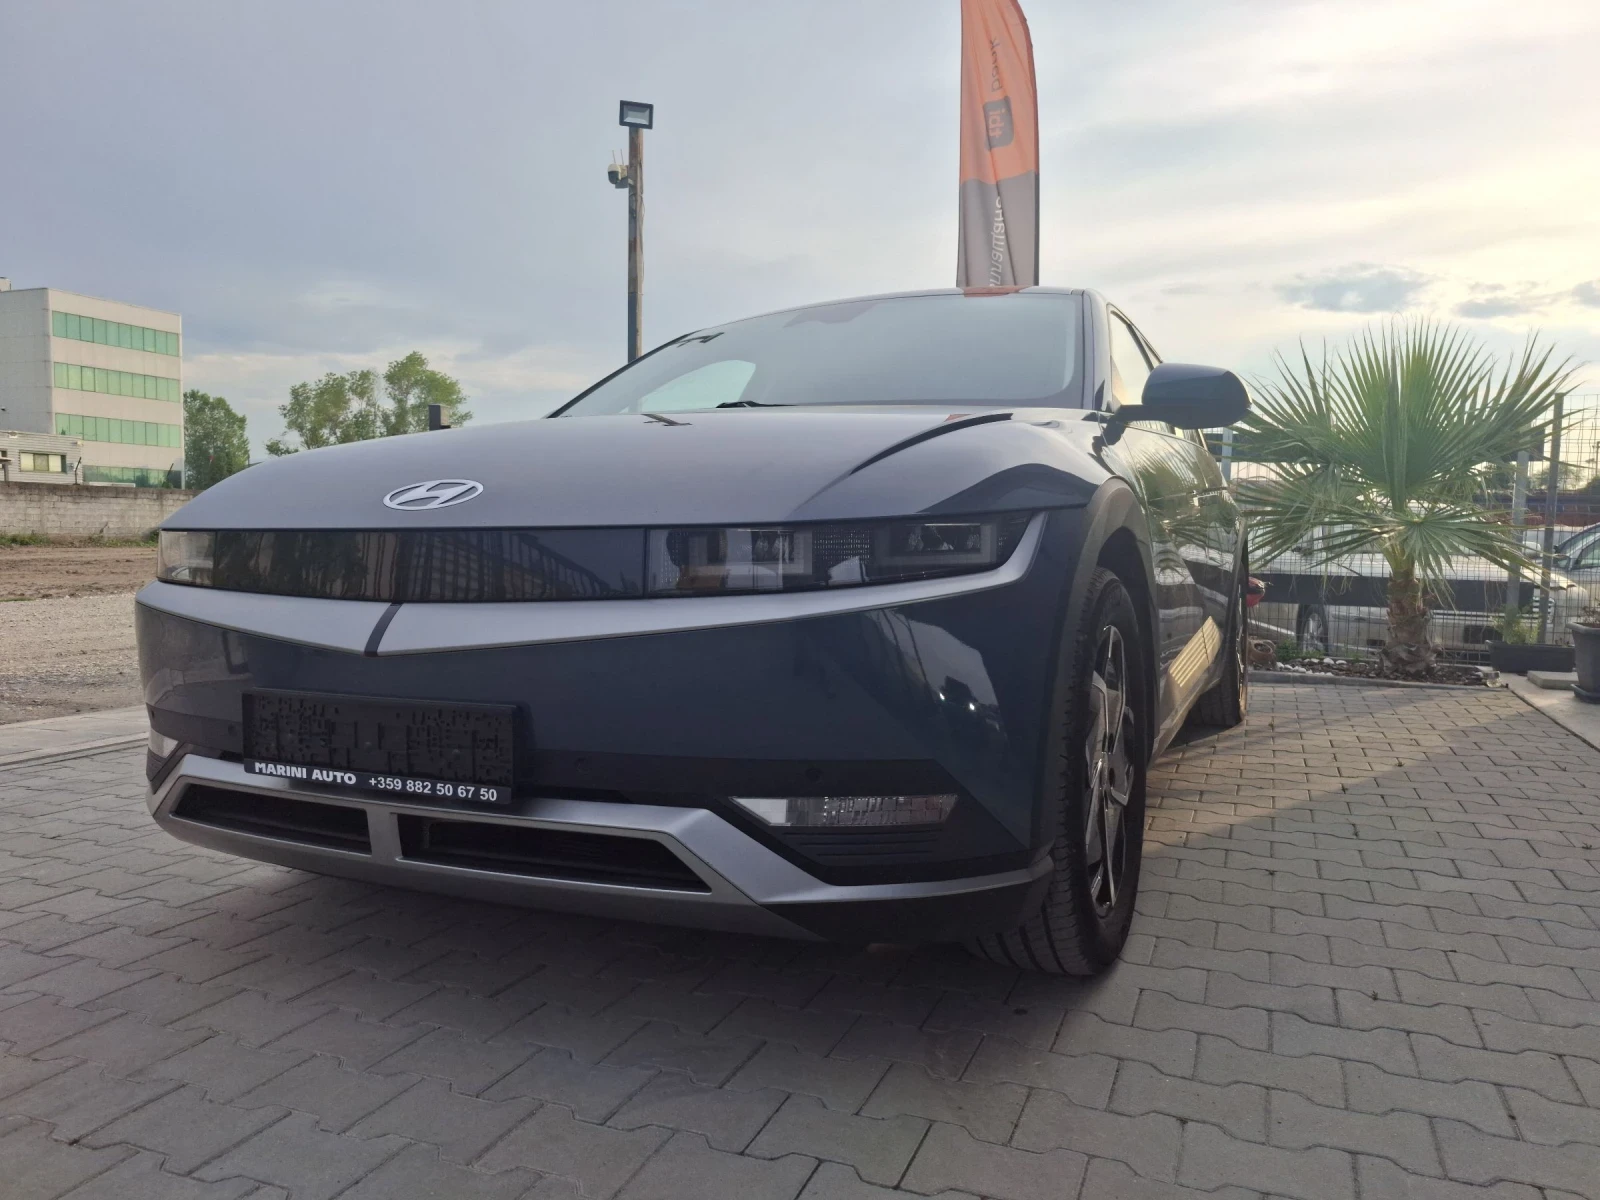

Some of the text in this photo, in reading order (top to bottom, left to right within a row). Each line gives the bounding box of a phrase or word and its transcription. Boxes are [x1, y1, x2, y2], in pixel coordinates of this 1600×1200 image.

[254, 761, 357, 785] MARINI AUTO
[368, 776, 498, 801] +359 882 50 67 50
